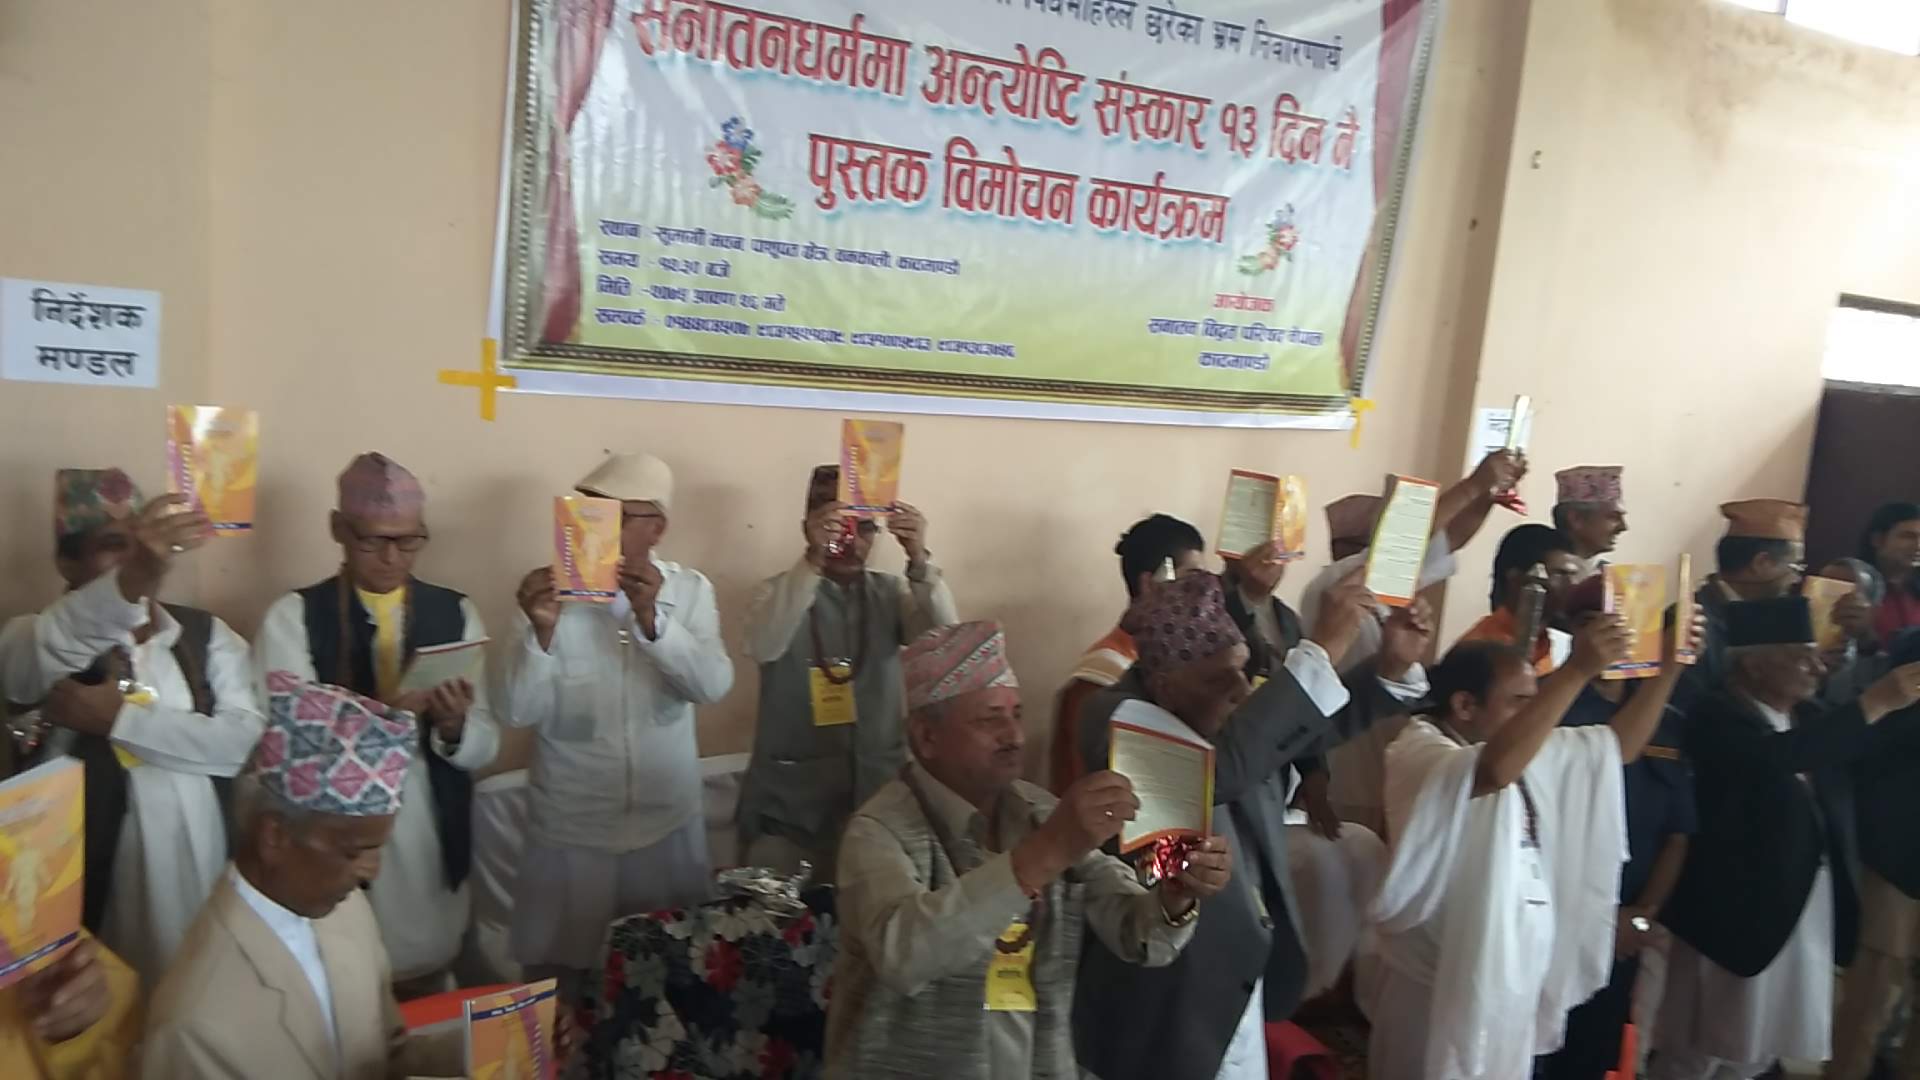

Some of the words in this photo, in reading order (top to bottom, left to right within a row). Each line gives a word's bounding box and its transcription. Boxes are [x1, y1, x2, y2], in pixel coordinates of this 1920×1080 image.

[1094, 70, 1212, 151] संस्कार
[1219, 102, 1257, 159] १३
[1268, 92, 1328, 165] दिन
[809, 133, 932, 210] पुस्तक
[943, 136, 1080, 225] विमोचन
[1087, 172, 1231, 243] कार्यक्रम
[30, 288, 147, 330] निर्देशक
[35, 344, 139, 378] मण्डल
